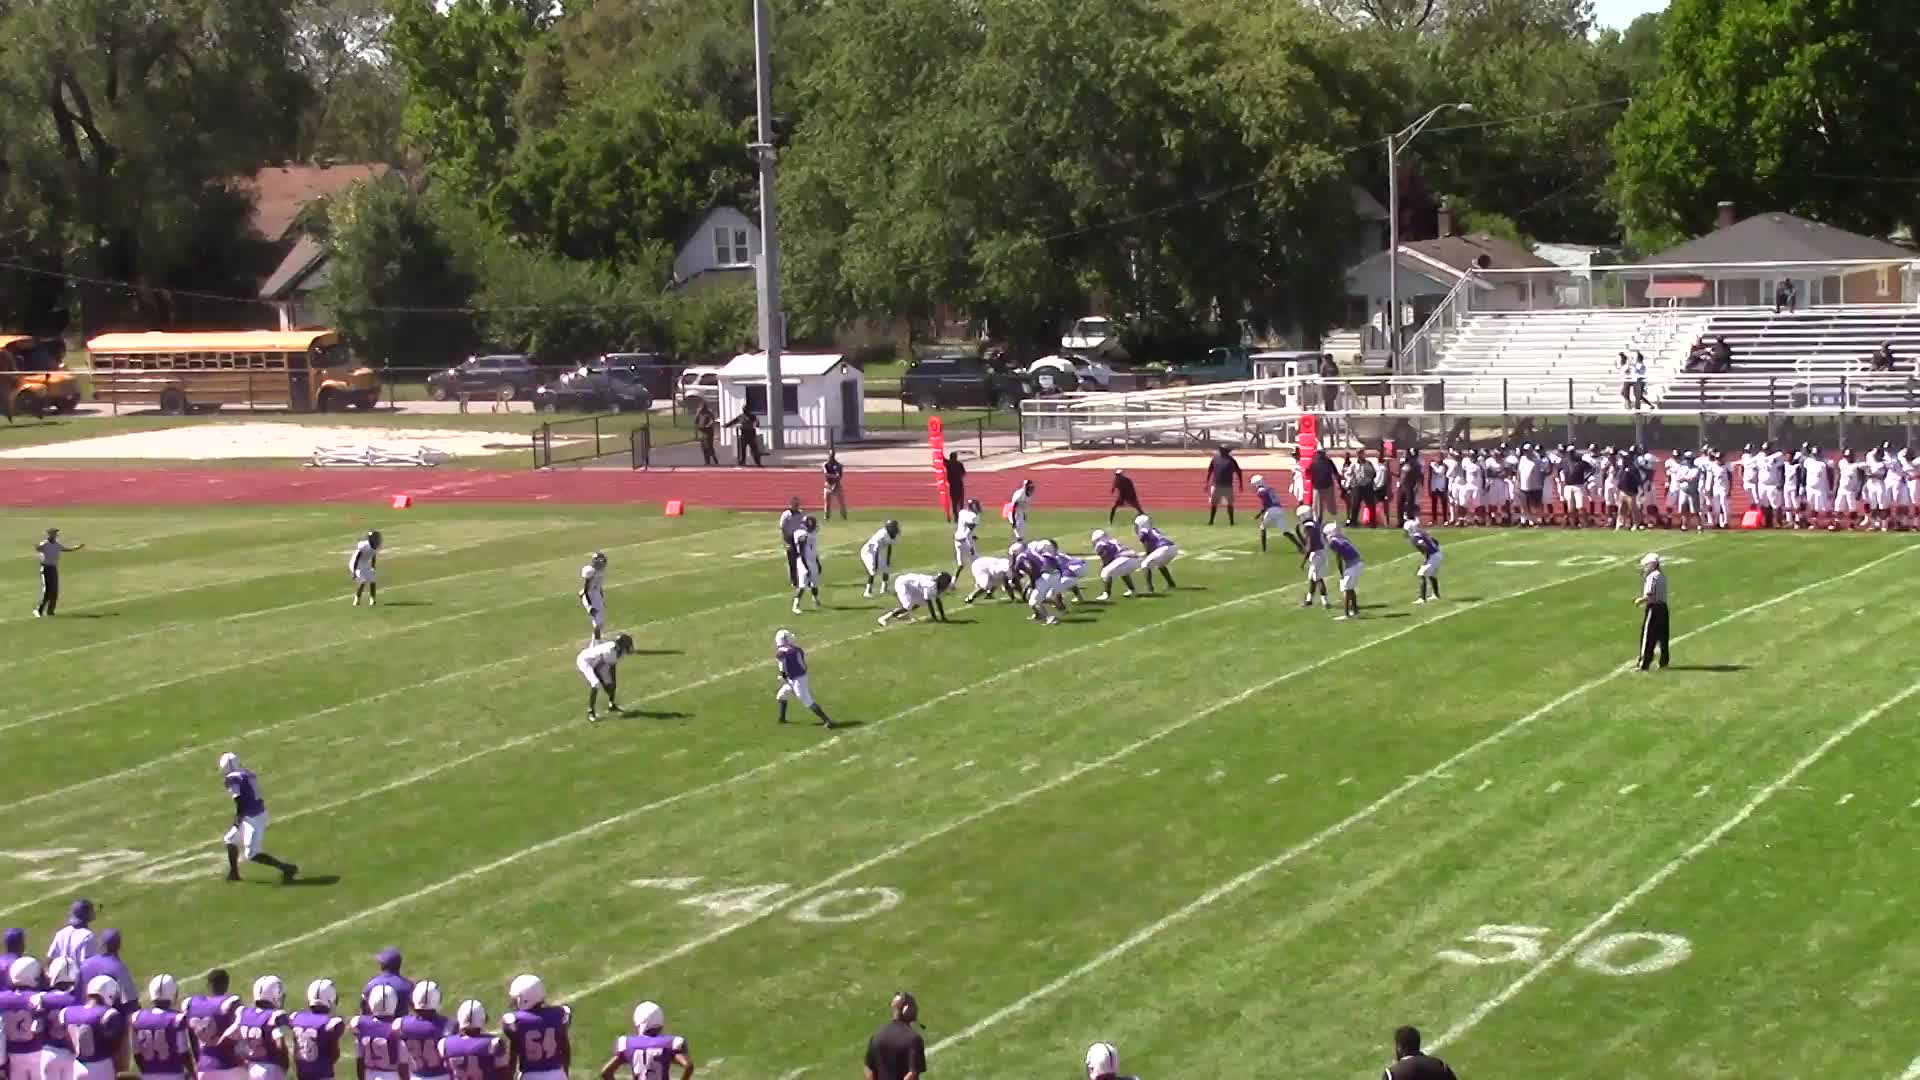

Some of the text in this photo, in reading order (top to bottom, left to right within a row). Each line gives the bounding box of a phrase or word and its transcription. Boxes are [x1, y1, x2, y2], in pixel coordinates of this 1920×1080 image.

[677, 881, 904, 922] 40
[1436, 924, 1693, 976] 50
[525, 1027, 558, 1063] 64
